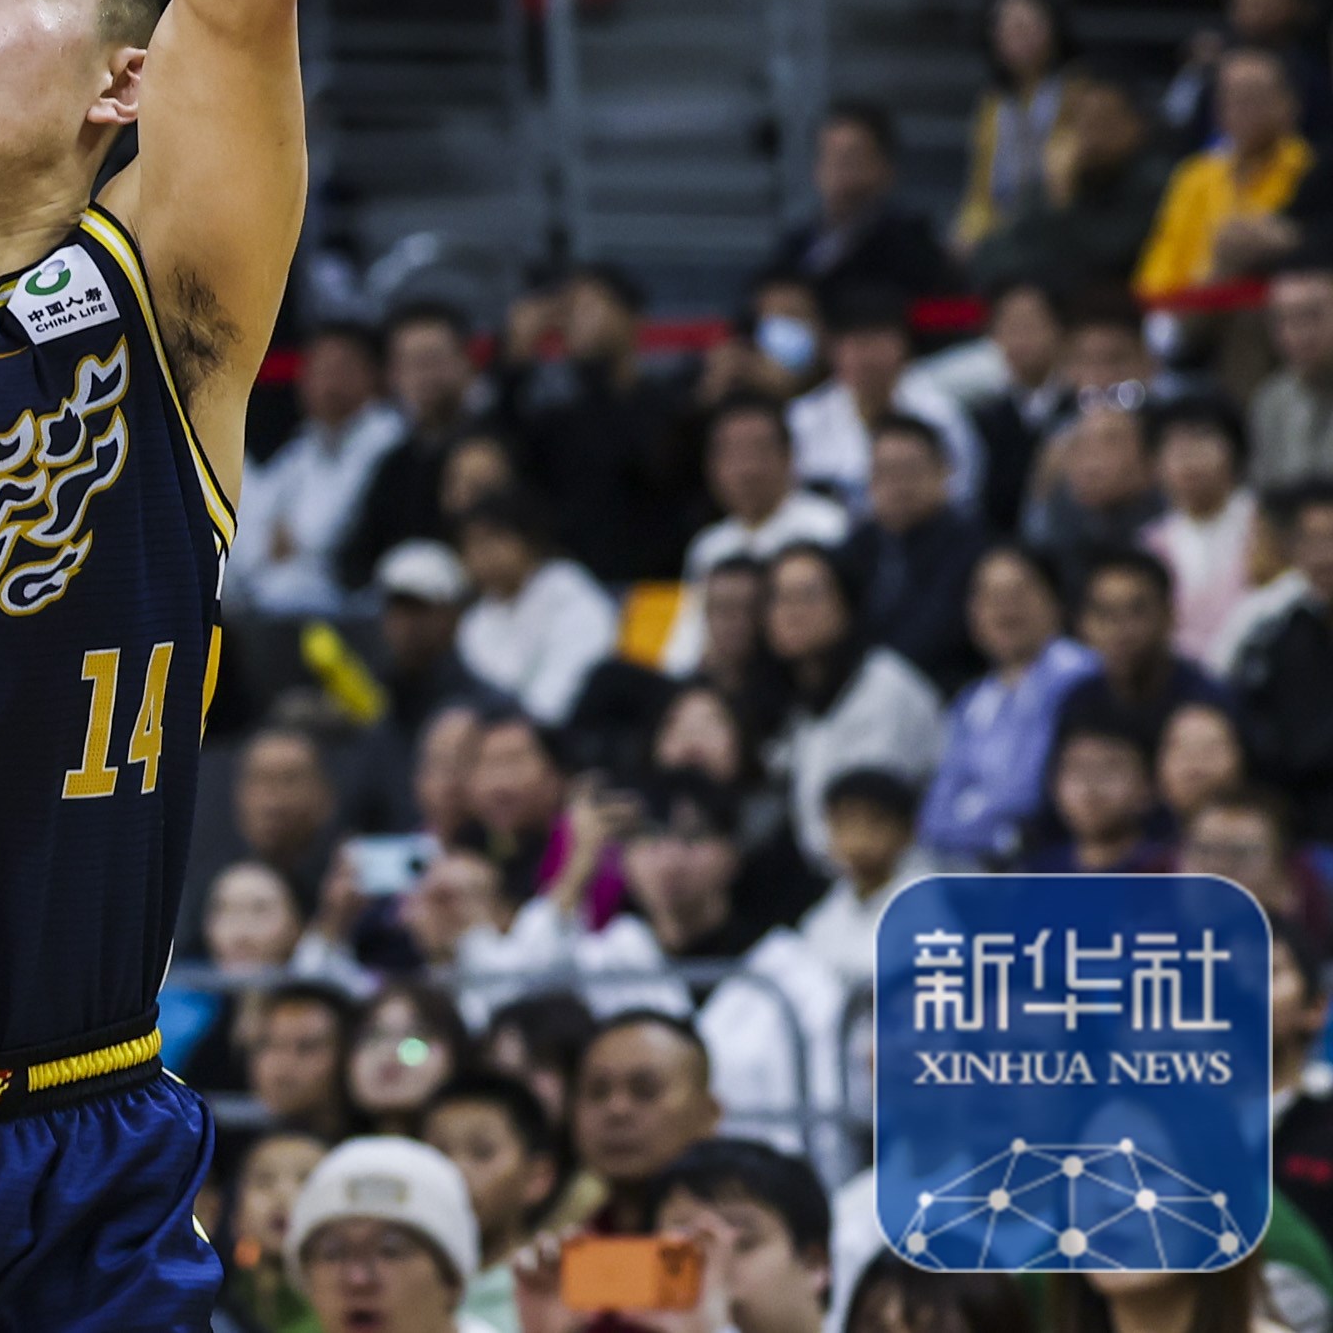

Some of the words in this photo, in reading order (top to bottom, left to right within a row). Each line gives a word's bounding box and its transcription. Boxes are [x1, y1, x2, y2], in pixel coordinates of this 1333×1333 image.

[27, 286, 102, 323] 中国人寿
[35, 313, 77, 333] CHINA
[79, 302, 108, 319] LIFE
[61, 640, 175, 799] 14
